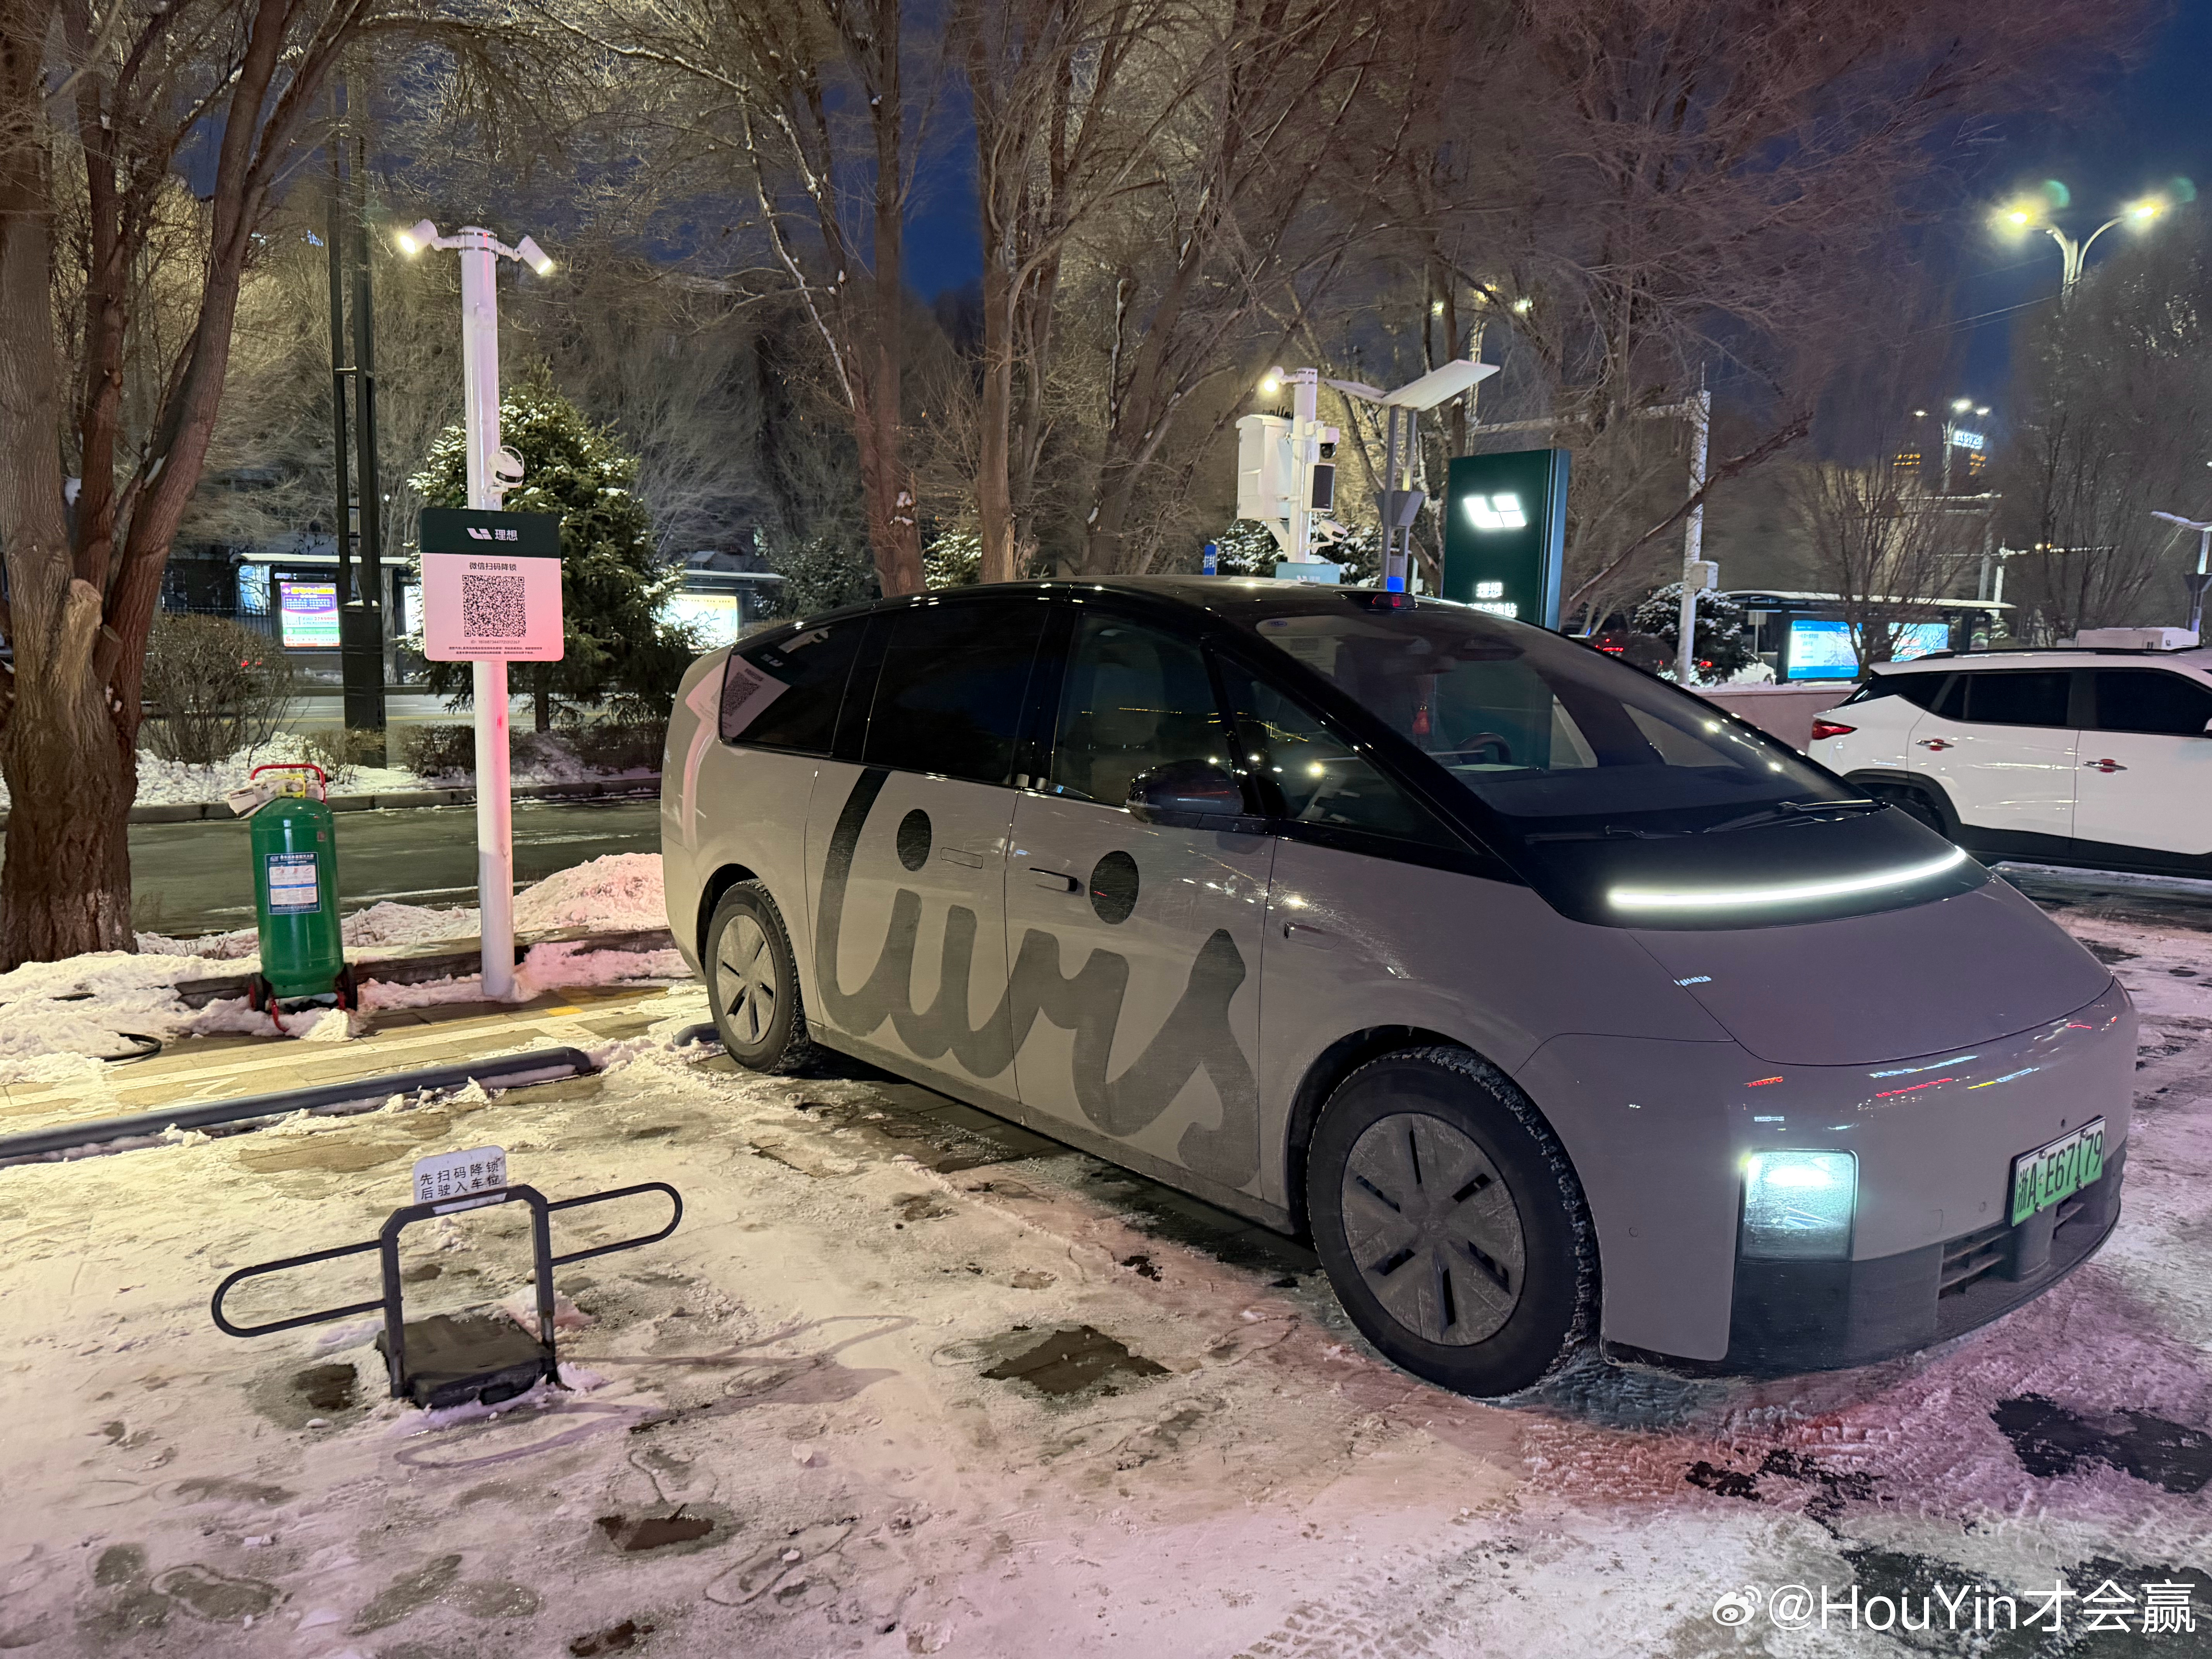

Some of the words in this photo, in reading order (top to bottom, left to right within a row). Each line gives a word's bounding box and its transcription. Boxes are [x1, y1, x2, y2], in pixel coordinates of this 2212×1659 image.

[495, 529, 518, 541] 理想
[469, 562, 517, 572] 微信扫码降锁
[1476, 582, 1503, 598] 理想
[420, 1160, 499, 1186] 先扫码降锁
[421, 1174, 500, 1200] 后驶入车位
